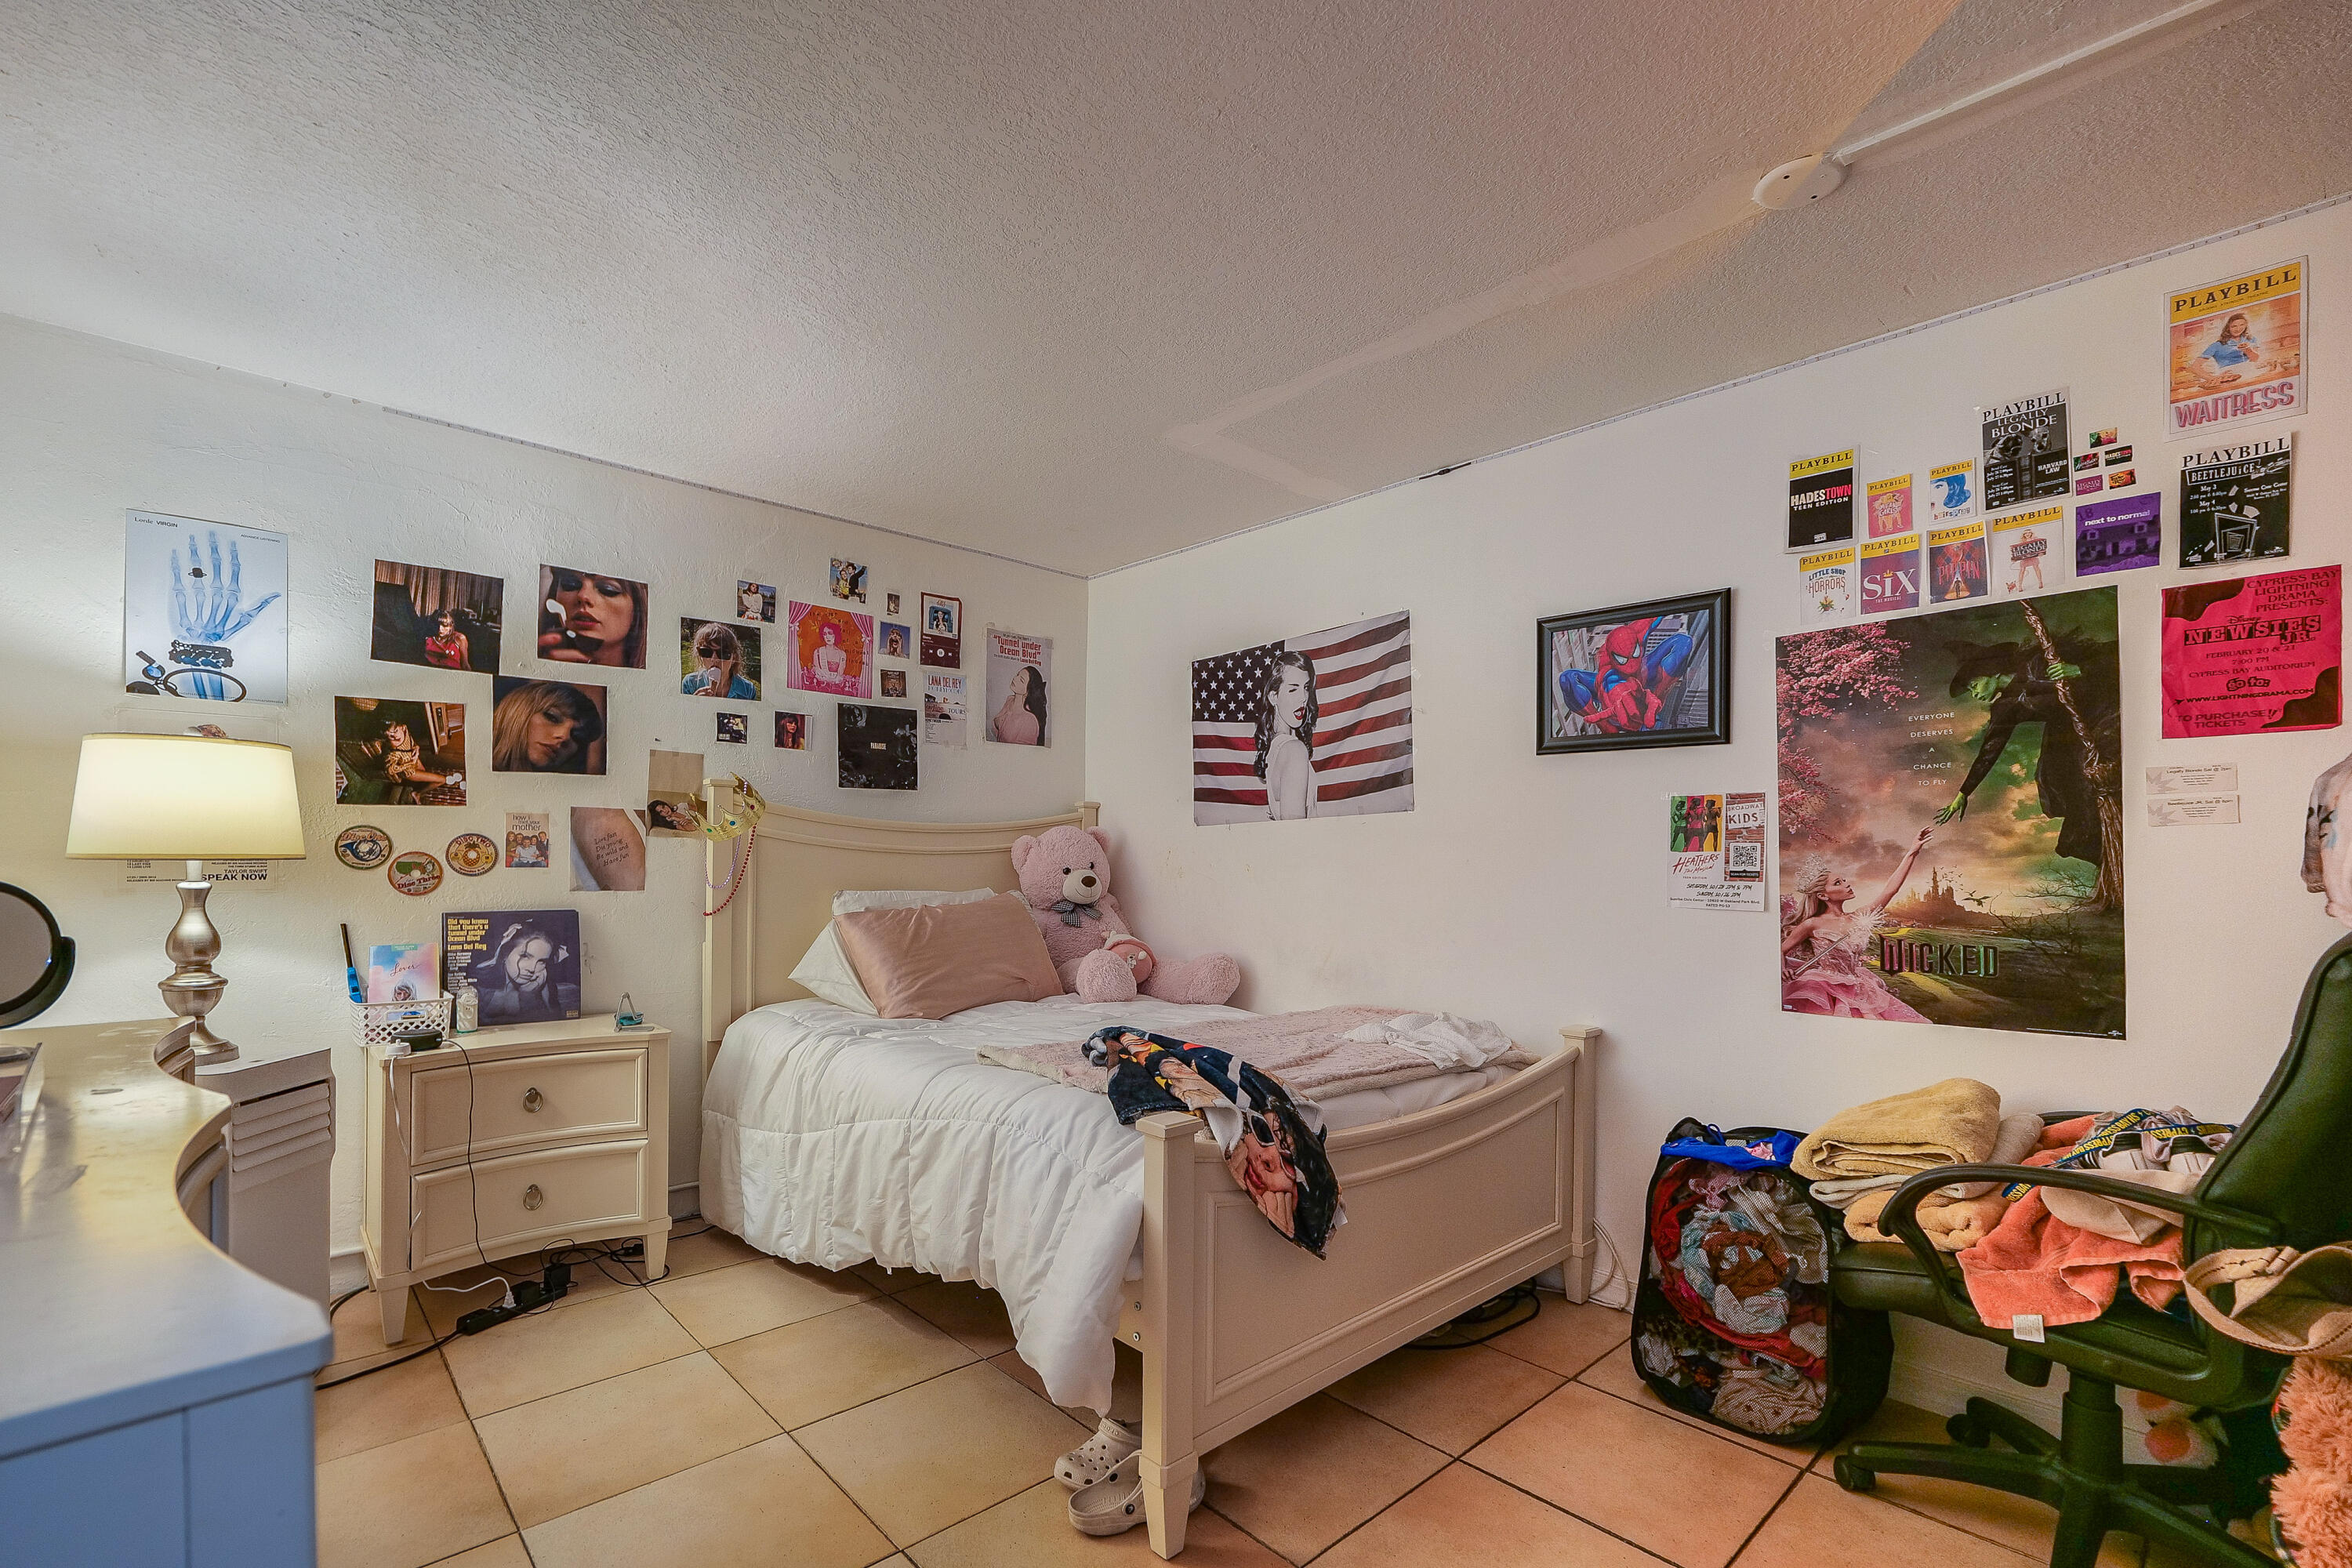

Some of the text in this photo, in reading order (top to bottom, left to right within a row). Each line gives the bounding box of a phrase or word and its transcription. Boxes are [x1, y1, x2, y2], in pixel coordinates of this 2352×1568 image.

[2174, 270, 2297, 312] PLAYBILL
[1983, 392, 2066, 422] PLAYBILL
[2176, 382, 2295, 427] WAITRESS
[1998, 408, 2049, 426] LEGALLY
[1991, 414, 2057, 438] BLONDE
[2183, 437, 2289, 468] PLAYBILL
[1791, 452, 1852, 472] PLAYBILL
[1931, 463, 1972, 476] PLAYBILL
[2038, 459, 2067, 471] HARVARD
[1870, 477, 1908, 491] PLAYBILL
[1791, 484, 1852, 506] HADESTOWN
[1793, 496, 1849, 511] TEEN EDITION
[1878, 508, 1900, 517] GIRLS
[1994, 506, 2060, 525] PLAYBILL
[2085, 517, 2105, 526] next
[2118, 510, 2151, 521] normal
[1931, 524, 1984, 541] PLAYBILL
[1864, 536, 1916, 551] PLAYBILL
[1802, 550, 1853, 565] PLAYBILL
[1809, 568, 1830, 581] LITTLE
[1939, 561, 1980, 585] PIPPIN
[2247, 569, 2338, 589] CYPRESS BAY
[1808, 577, 1846, 596] HORRORS
[2255, 579, 2330, 597] LIGHTNING
[2268, 590, 2317, 603] DRAMA
[2256, 597, 2328, 612] PRESENTS:
[2184, 615, 2321, 646] NEWSIES
[1000, 645, 1020, 657] Ocean
[1022, 641, 1042, 652] under
[2206, 649, 2252, 659] FEBRUARY
[2189, 662, 2315, 679] CYPRESS BAY AUDITORIUM
[927, 674, 962, 689] LANA DEL REY
[1908, 712, 1955, 722] EVERYONE
[2195, 720, 2246, 728] TICKETS
[1910, 728, 1954, 738] DESERVES
[1727, 802, 1763, 811] BROADWAY
[1729, 812, 1759, 825] KIDS
[476, 836, 492, 848] TWO
[594, 837, 607, 845] Live
[606, 838, 623, 849] young
[605, 848, 618, 857] wild
[619, 843, 629, 851] and
[604, 853, 630, 866] Have fun
[1672, 853, 1720, 875] HEATHERS
[416, 875, 441, 884] Three
[1880, 935, 1999, 977] WICKED
[2118, 1112, 2140, 1129] BAY HS
